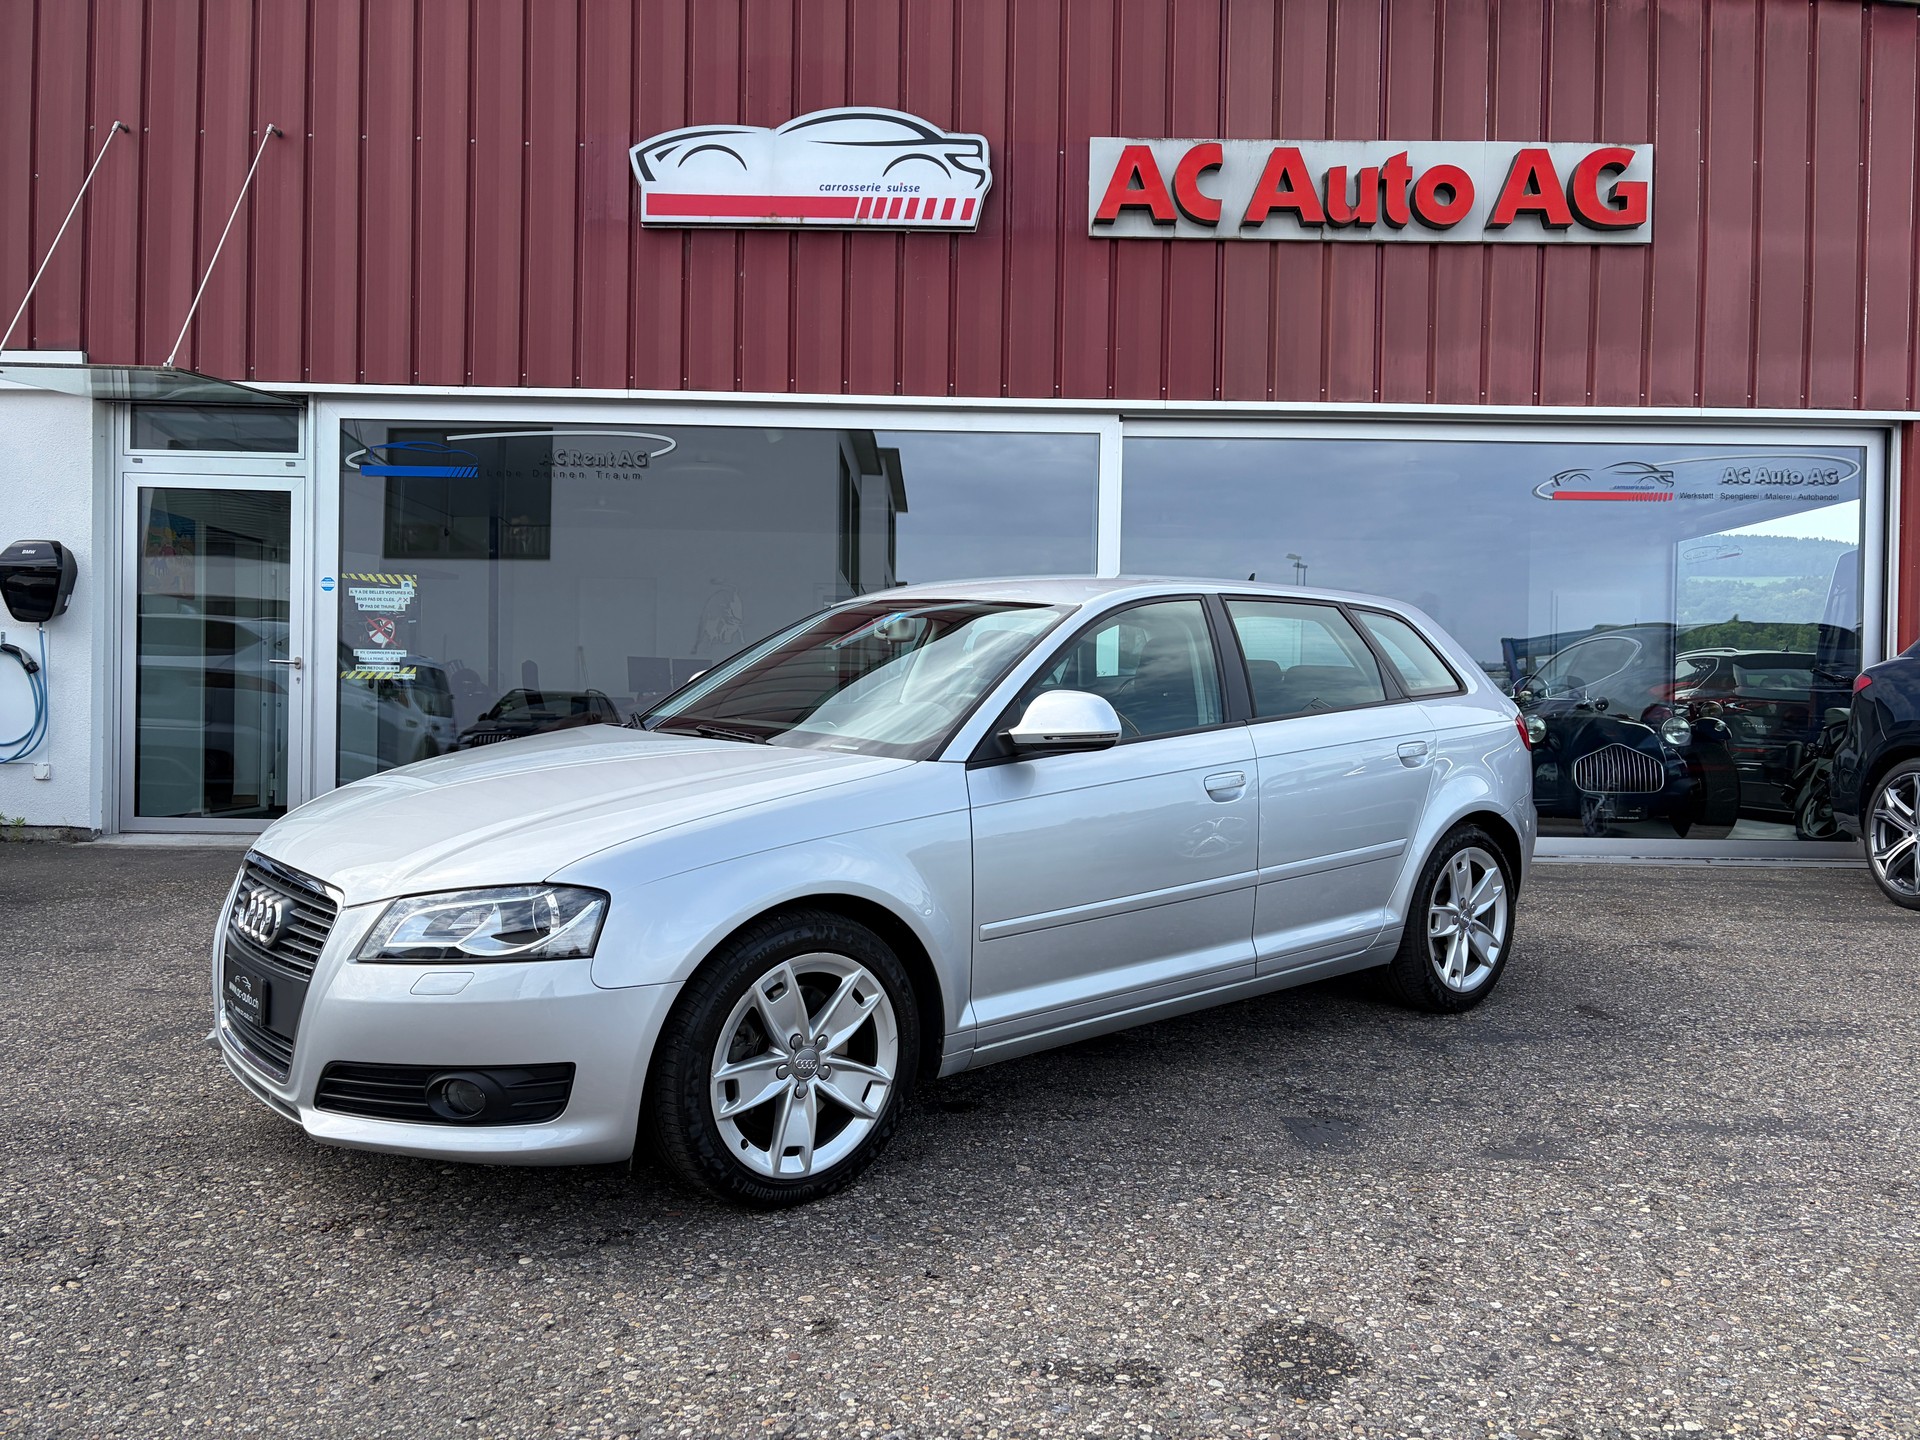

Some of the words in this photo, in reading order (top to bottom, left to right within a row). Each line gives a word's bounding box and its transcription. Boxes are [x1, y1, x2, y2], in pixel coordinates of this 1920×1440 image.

[819, 182, 881, 193] carrosserie
[886, 182, 921, 193] suisse
[1093, 142, 1223, 227] AC
[1240, 146, 1475, 230] Auto
[1485, 147, 1648, 231] AG
[569, 450, 615, 468] Rent
[617, 451, 649, 469] AG
[532, 470, 584, 481] Deinen
[595, 471, 642, 482] Traum
[1721, 467, 1751, 485] AC
[1755, 467, 1804, 486] Auto
[1807, 468, 1840, 486] AG
